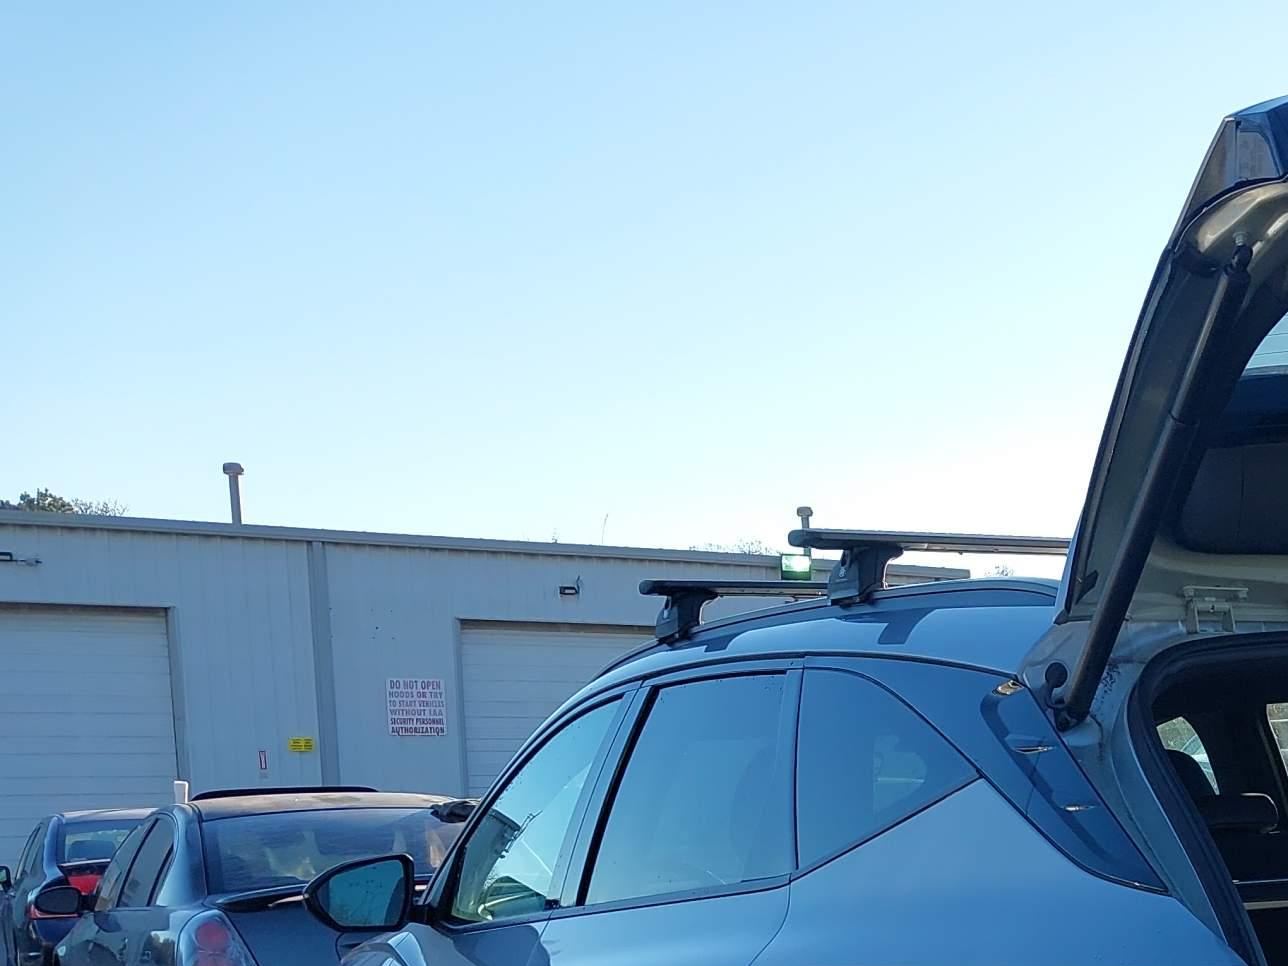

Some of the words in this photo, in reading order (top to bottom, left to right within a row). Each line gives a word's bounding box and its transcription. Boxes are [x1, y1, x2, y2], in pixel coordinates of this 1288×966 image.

[390, 680, 400, 690] DO
[403, 680, 418, 690] NOT
[420, 680, 441, 690] OPEN
[416, 691, 427, 699] OR
[428, 691, 443, 699] TRY
[398, 700, 417, 708] START
[418, 700, 445, 708] VEHICLES
[390, 717, 414, 725] SECURITY
[415, 717, 444, 725] PERSONNEL
[391, 726, 445, 734] AUTHORIZATION
